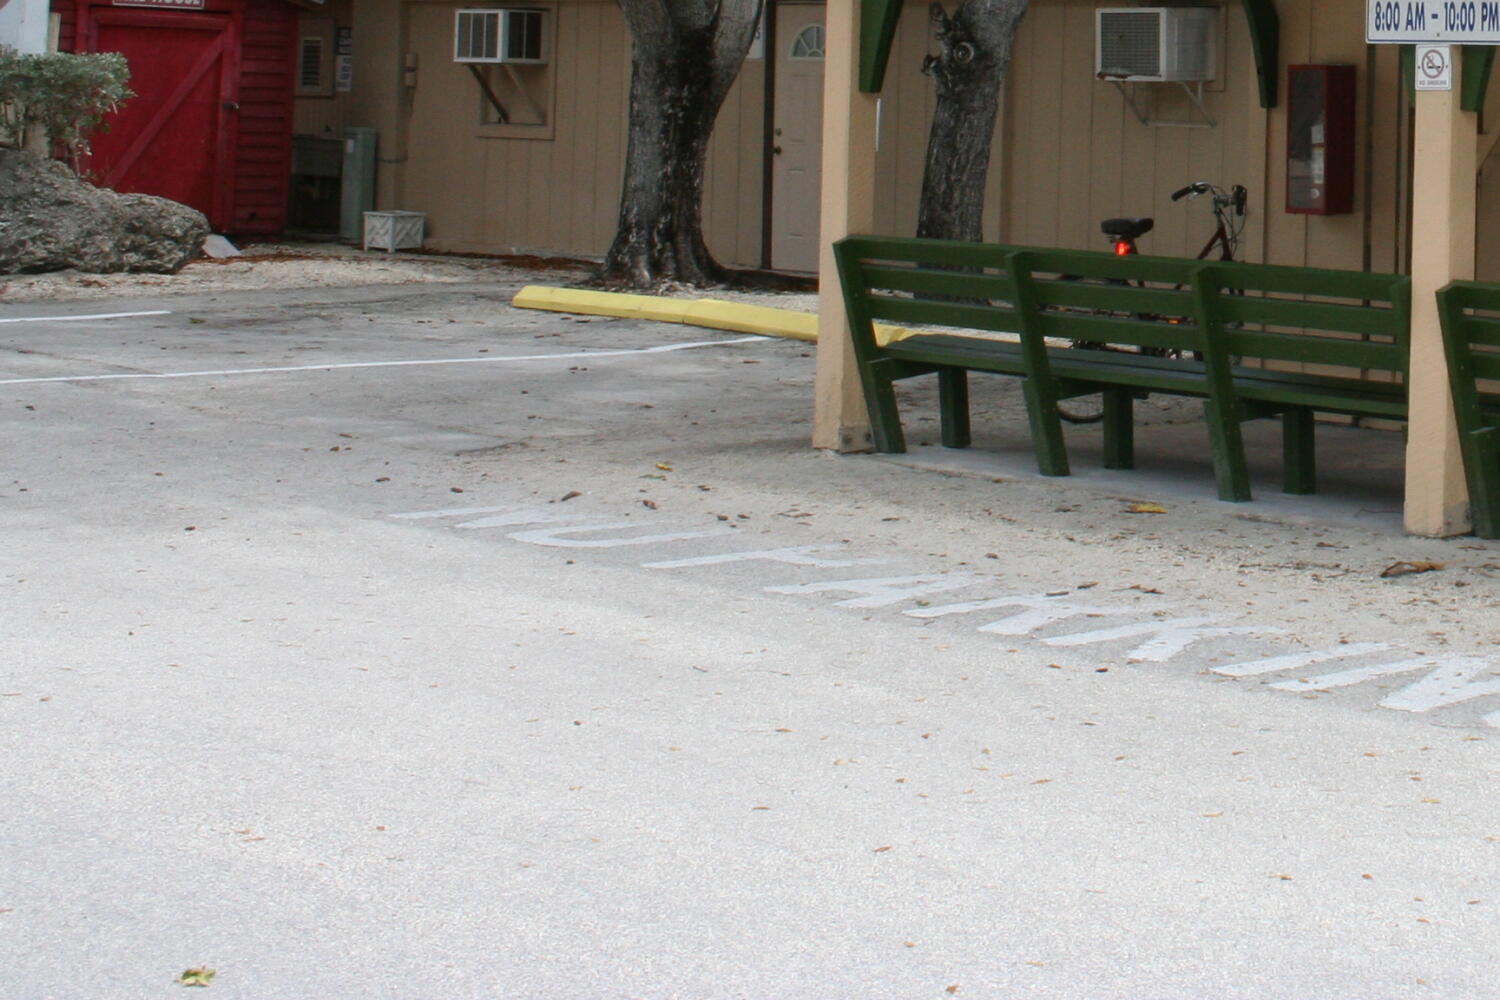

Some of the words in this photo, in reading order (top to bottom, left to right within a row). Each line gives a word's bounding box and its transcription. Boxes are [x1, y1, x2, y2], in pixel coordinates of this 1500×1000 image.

[1375, 1, 1400, 31] 8:00
[1405, 1, 1425, 31] AM
[1444, 1, 1475, 32] 10:00
[1481, 2, 1499, 32] PM
